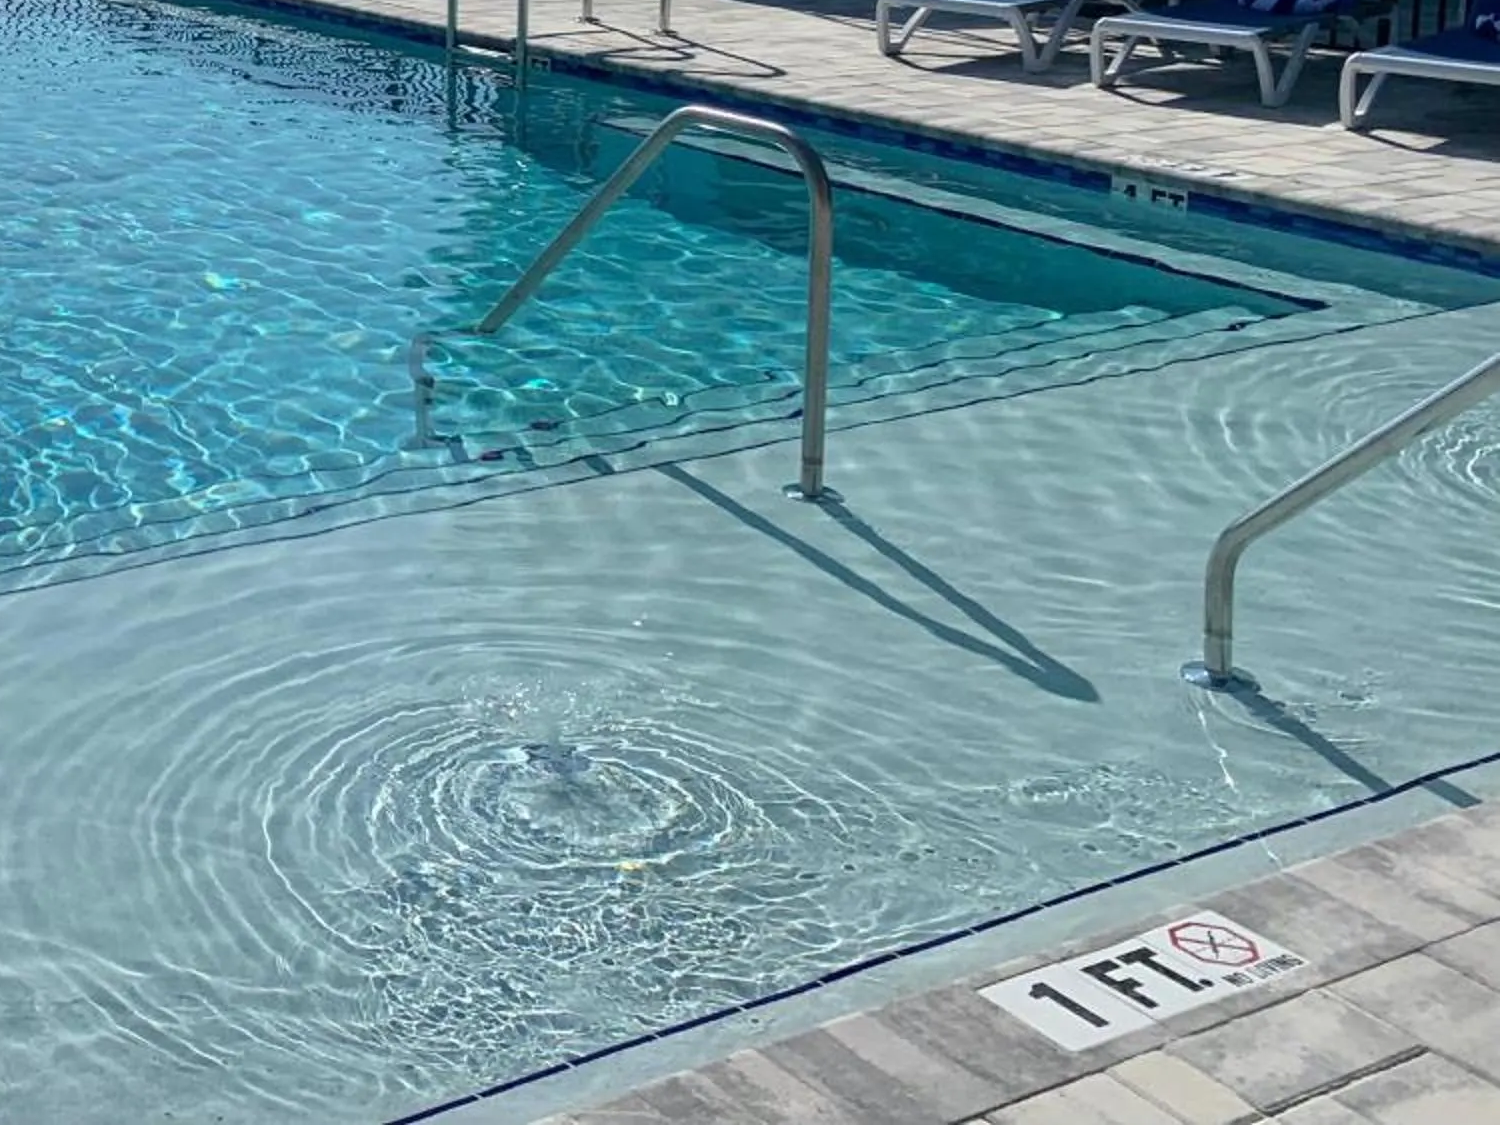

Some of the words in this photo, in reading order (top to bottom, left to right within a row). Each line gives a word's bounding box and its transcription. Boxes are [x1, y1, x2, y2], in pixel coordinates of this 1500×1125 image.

[1029, 981, 1110, 1028] 1
[1079, 946, 1215, 1010] FT.
[1222, 973, 1249, 988] NO
